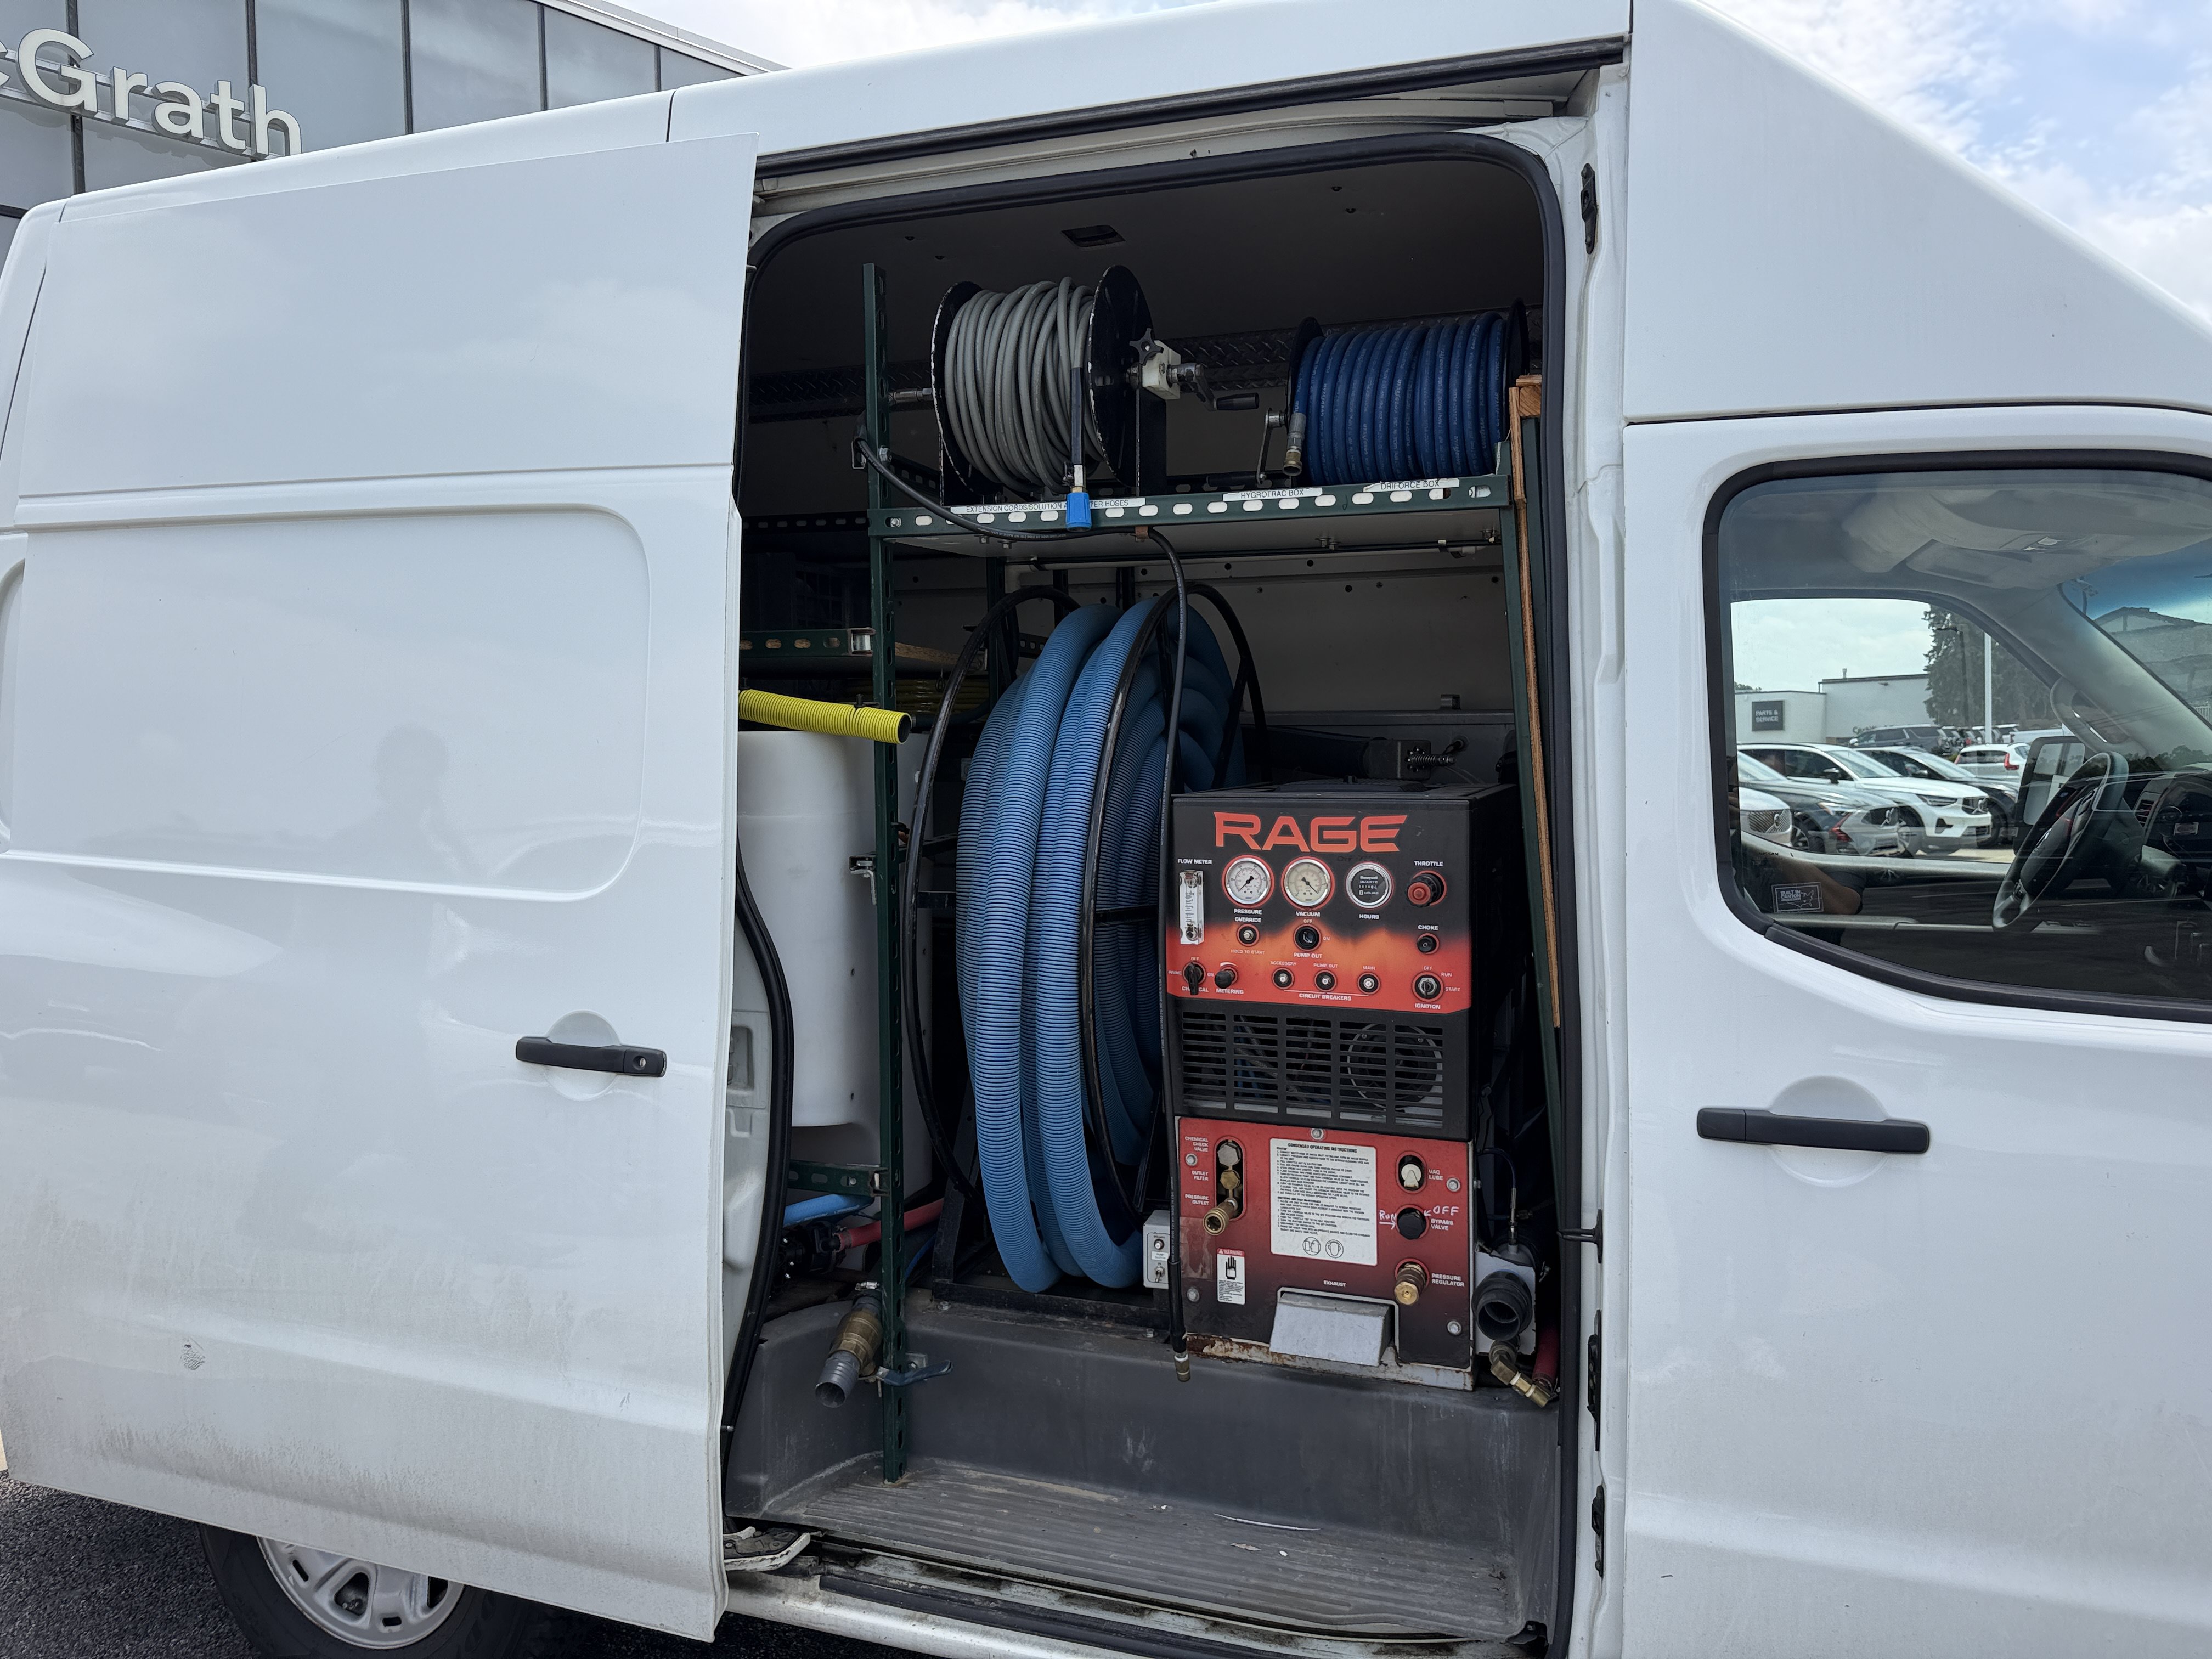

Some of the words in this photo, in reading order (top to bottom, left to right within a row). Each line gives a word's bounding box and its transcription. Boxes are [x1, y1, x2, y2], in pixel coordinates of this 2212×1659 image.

[0, 28, 302, 156] Grath
[1381, 481, 1421, 490] DRIFORCE
[1423, 479, 1441, 488] BOX
[1240, 489, 1288, 499] HYGROTRAC
[1289, 488, 1305, 496] BOX
[966, 504, 1003, 513] EXTENSION
[1003, 502, 1062, 512] CORDS/SOLUTION
[1105, 499, 1129, 507] HOSES
[1214, 811, 1408, 853] RAGE
[1432, 1205, 1459, 1216] OFF
[1431, 1273, 1462, 1282] PRESSURE
[1431, 1279, 1465, 1287] REGULATOR
